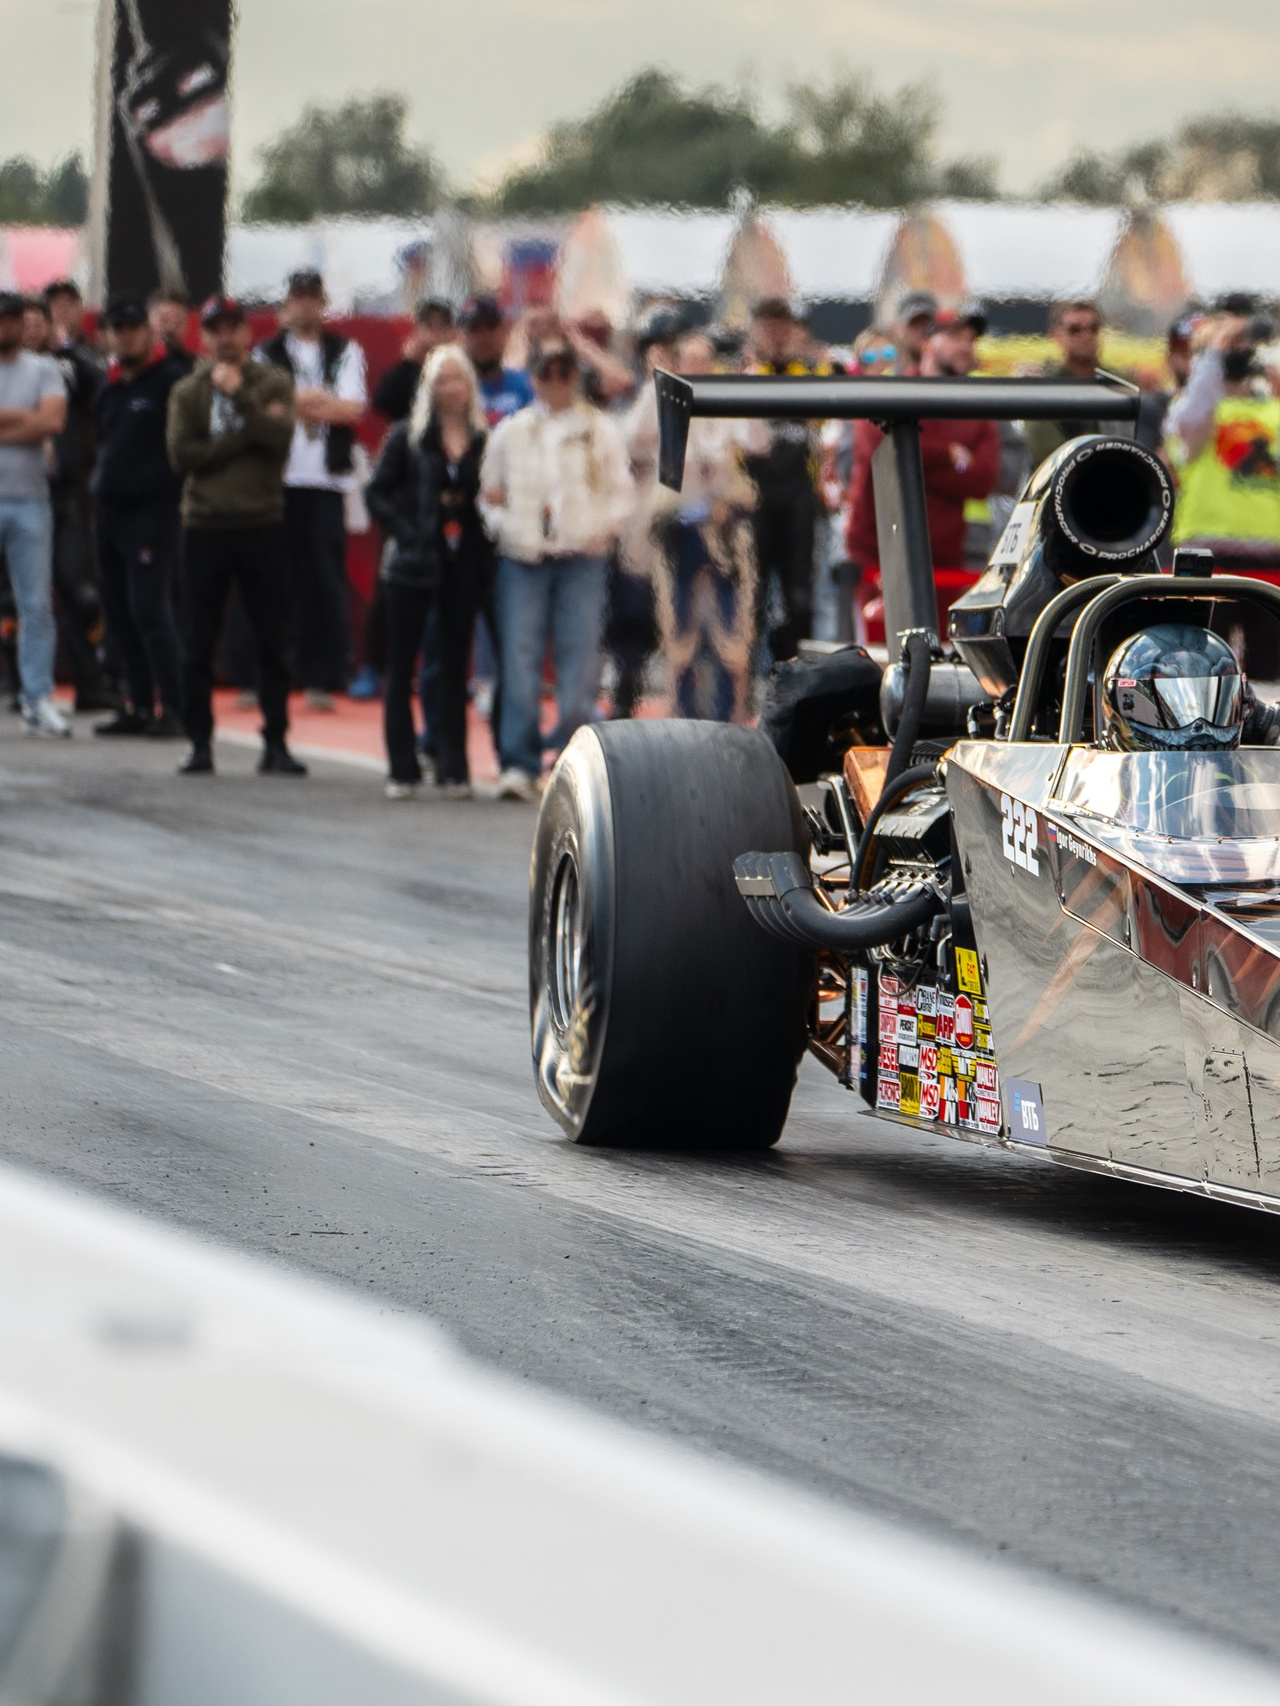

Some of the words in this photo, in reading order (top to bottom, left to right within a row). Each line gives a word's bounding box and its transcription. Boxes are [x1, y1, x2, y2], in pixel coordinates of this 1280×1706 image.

[1095, 441, 1169, 489] PROCHARGER
[1054, 458, 1079, 545] PROCHARGER
[1097, 510, 1170, 561] PROCHARGER
[1000, 791, 1040, 878] 222
[920, 1046, 938, 1072] MSD
[920, 1083, 939, 1108] MSD
[1021, 1099, 1039, 1131] ВТБ
